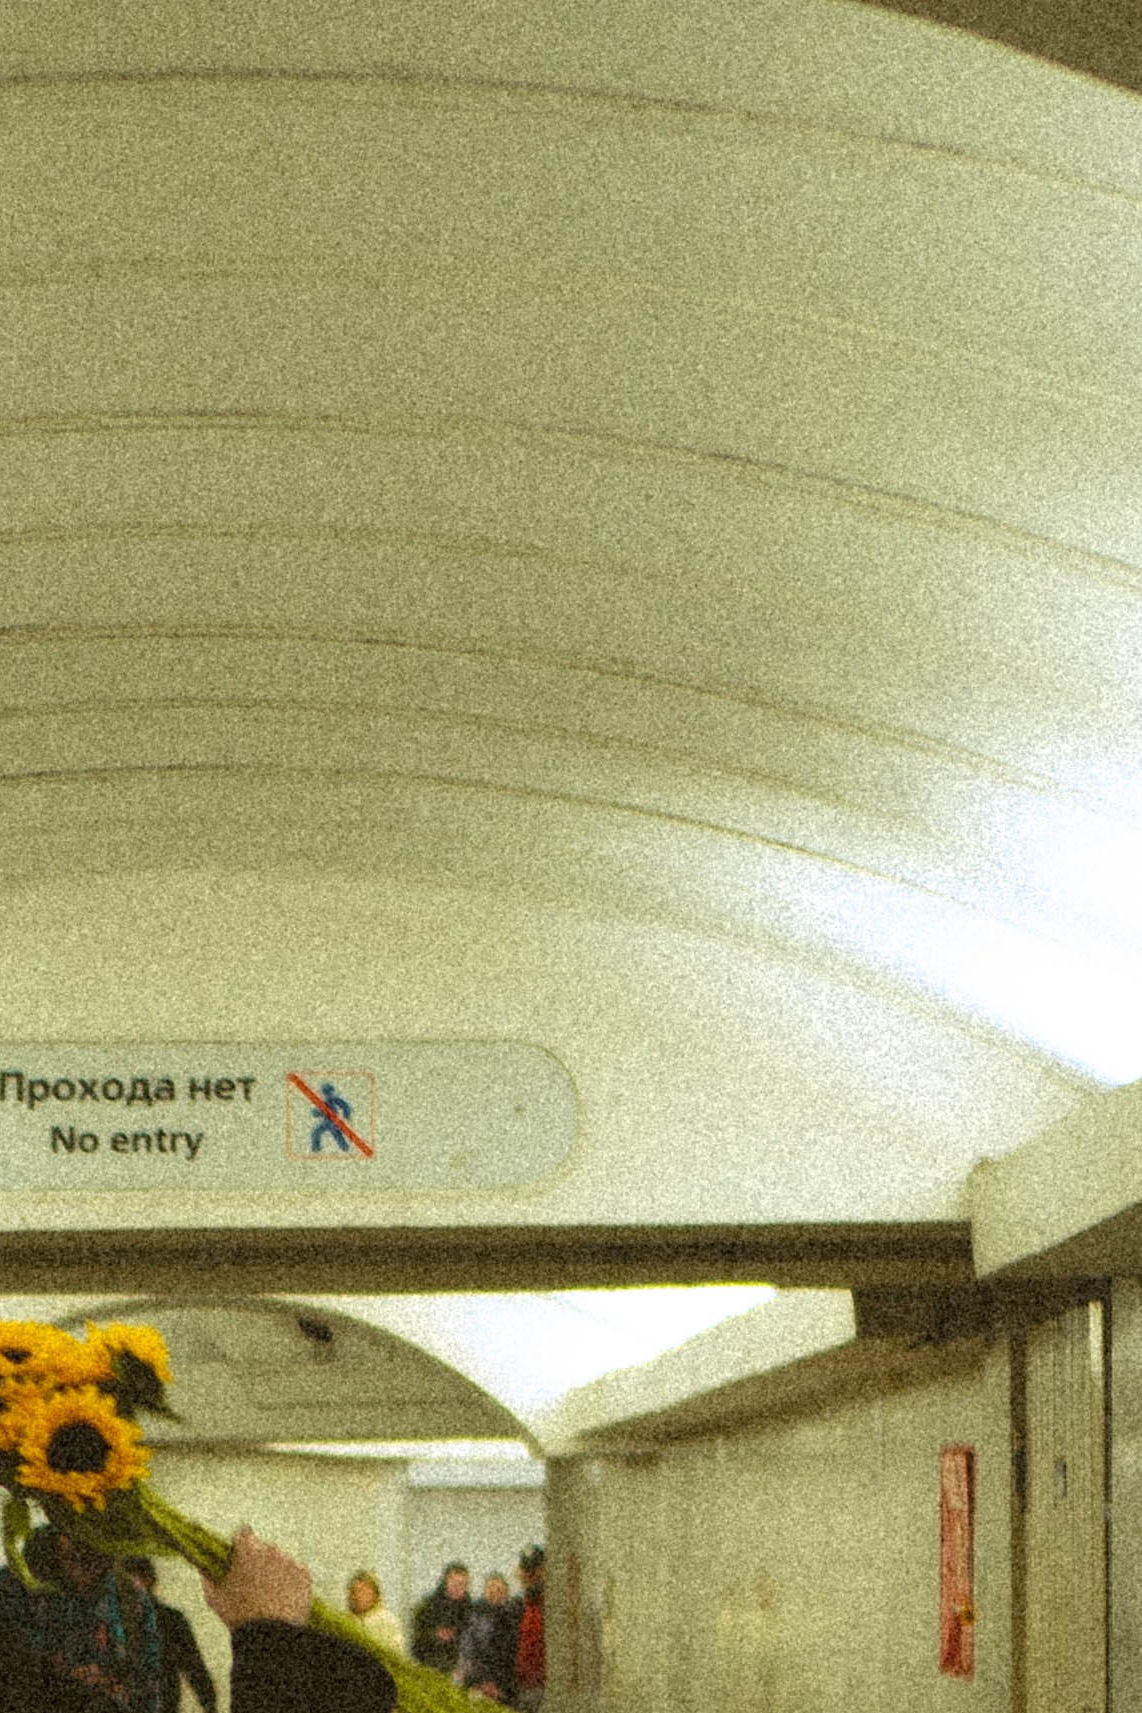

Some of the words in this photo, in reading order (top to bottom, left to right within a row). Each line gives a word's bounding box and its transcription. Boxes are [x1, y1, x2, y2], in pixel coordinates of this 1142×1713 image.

[0, 1070, 176, 1109] Прохода
[187, 1077, 255, 1103] нет
[50, 1126, 99, 1155] No
[109, 1127, 204, 1160] entry
